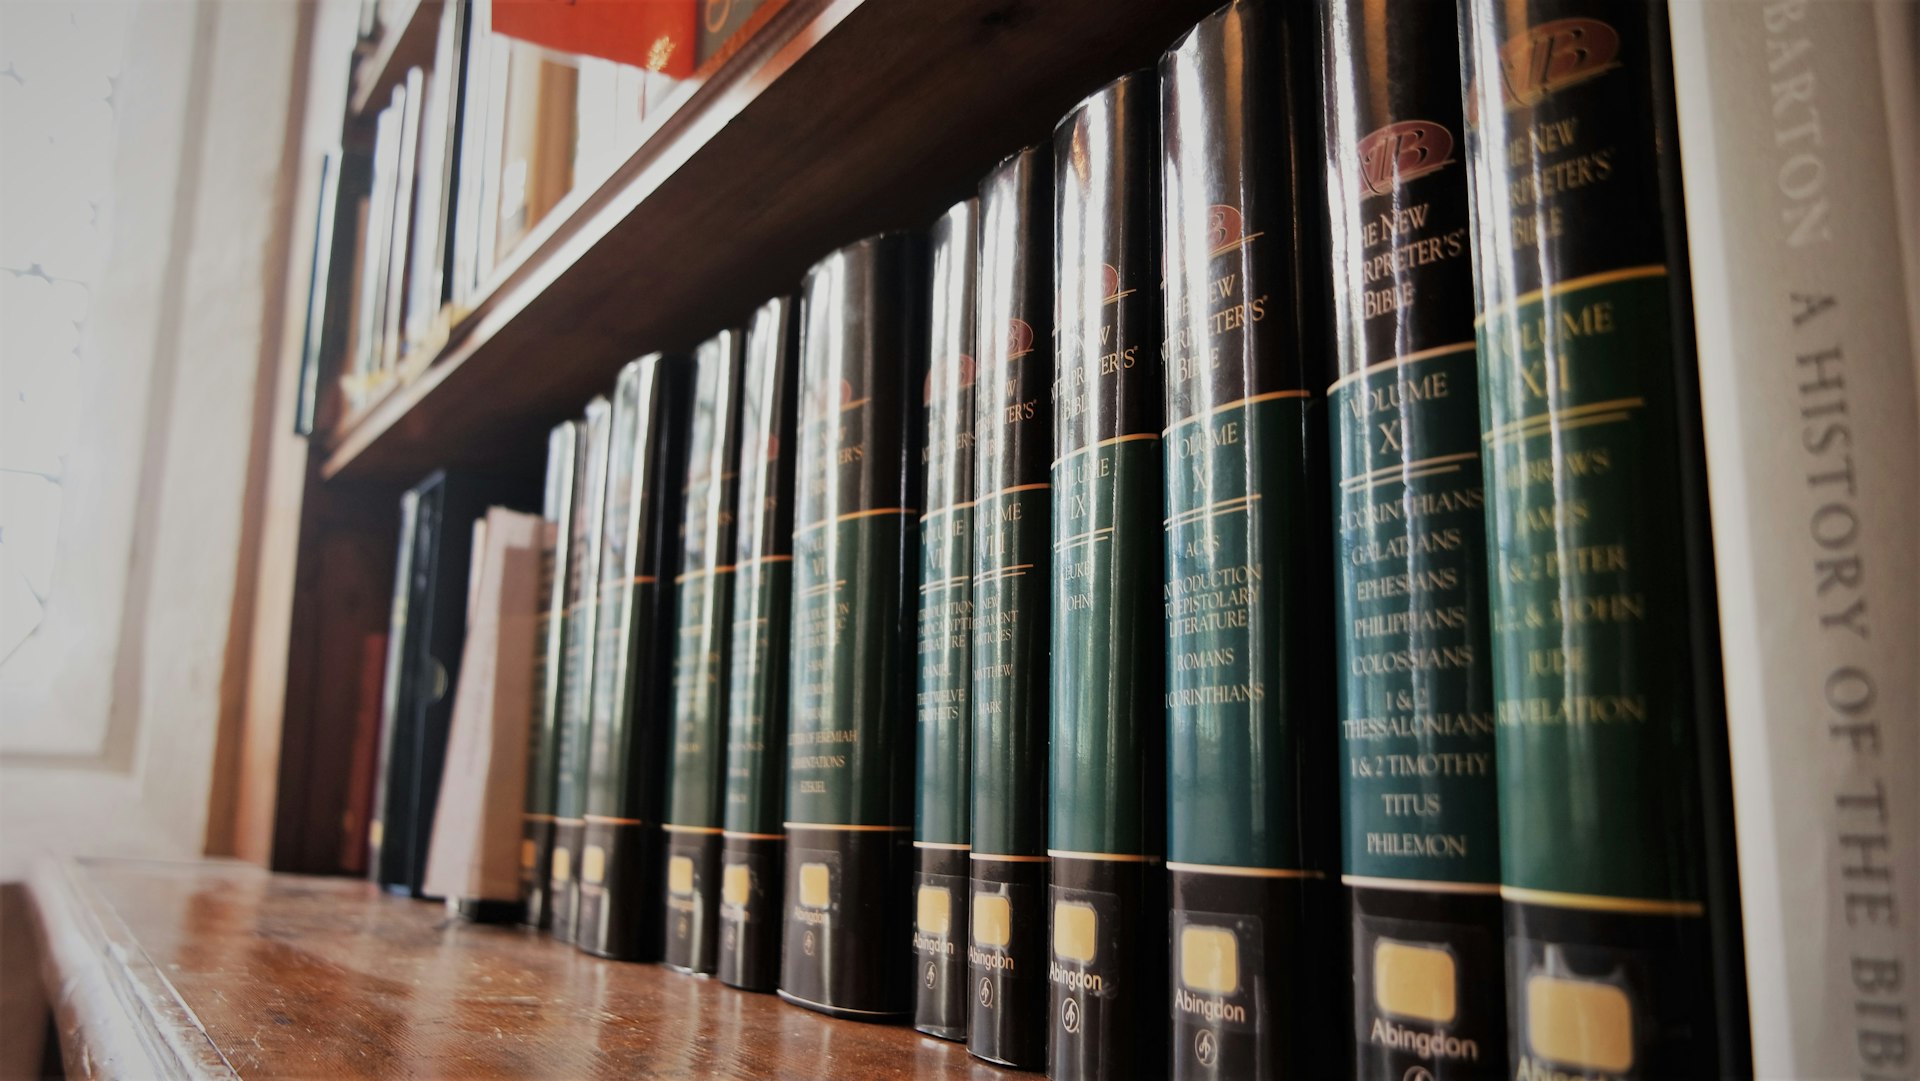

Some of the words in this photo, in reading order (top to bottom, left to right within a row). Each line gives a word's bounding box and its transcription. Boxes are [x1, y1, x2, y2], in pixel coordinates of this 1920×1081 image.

[1380, 203, 1429, 242] NEW
[1790, 291, 1838, 327] A
[1070, 492, 1087, 521] IX
[1795, 345, 1871, 642] HISTORY
[1351, 527, 1462, 567] GALATIANS
[1356, 567, 1457, 601] EPHESIANS
[1169, 608, 1248, 639] LITERATURE
[1354, 606, 1466, 640] PHILIPPIANS
[1177, 647, 1236, 672] ROMANS
[1351, 644, 1475, 677] COLOSSIANS
[1169, 681, 1265, 708] CORINTHIANS
[1823, 665, 1882, 757] OF
[1342, 712, 1495, 742] THESSALONIANS
[1359, 756, 1373, 778] &
[1387, 752, 1489, 777] TIMOTHY
[1381, 792, 1442, 818] TITUS
[1367, 831, 1468, 859] PHILEMON
[1833, 778, 1899, 930] THE
[913, 932, 954, 956] Abingdon
[968, 947, 1014, 972] Abingdon
[1050, 961, 1103, 992] Abingdon
[1174, 988, 1246, 1023] Abingdon
[1849, 955, 1914, 1081] BIB
[1370, 1016, 1479, 1061] Abingdon
